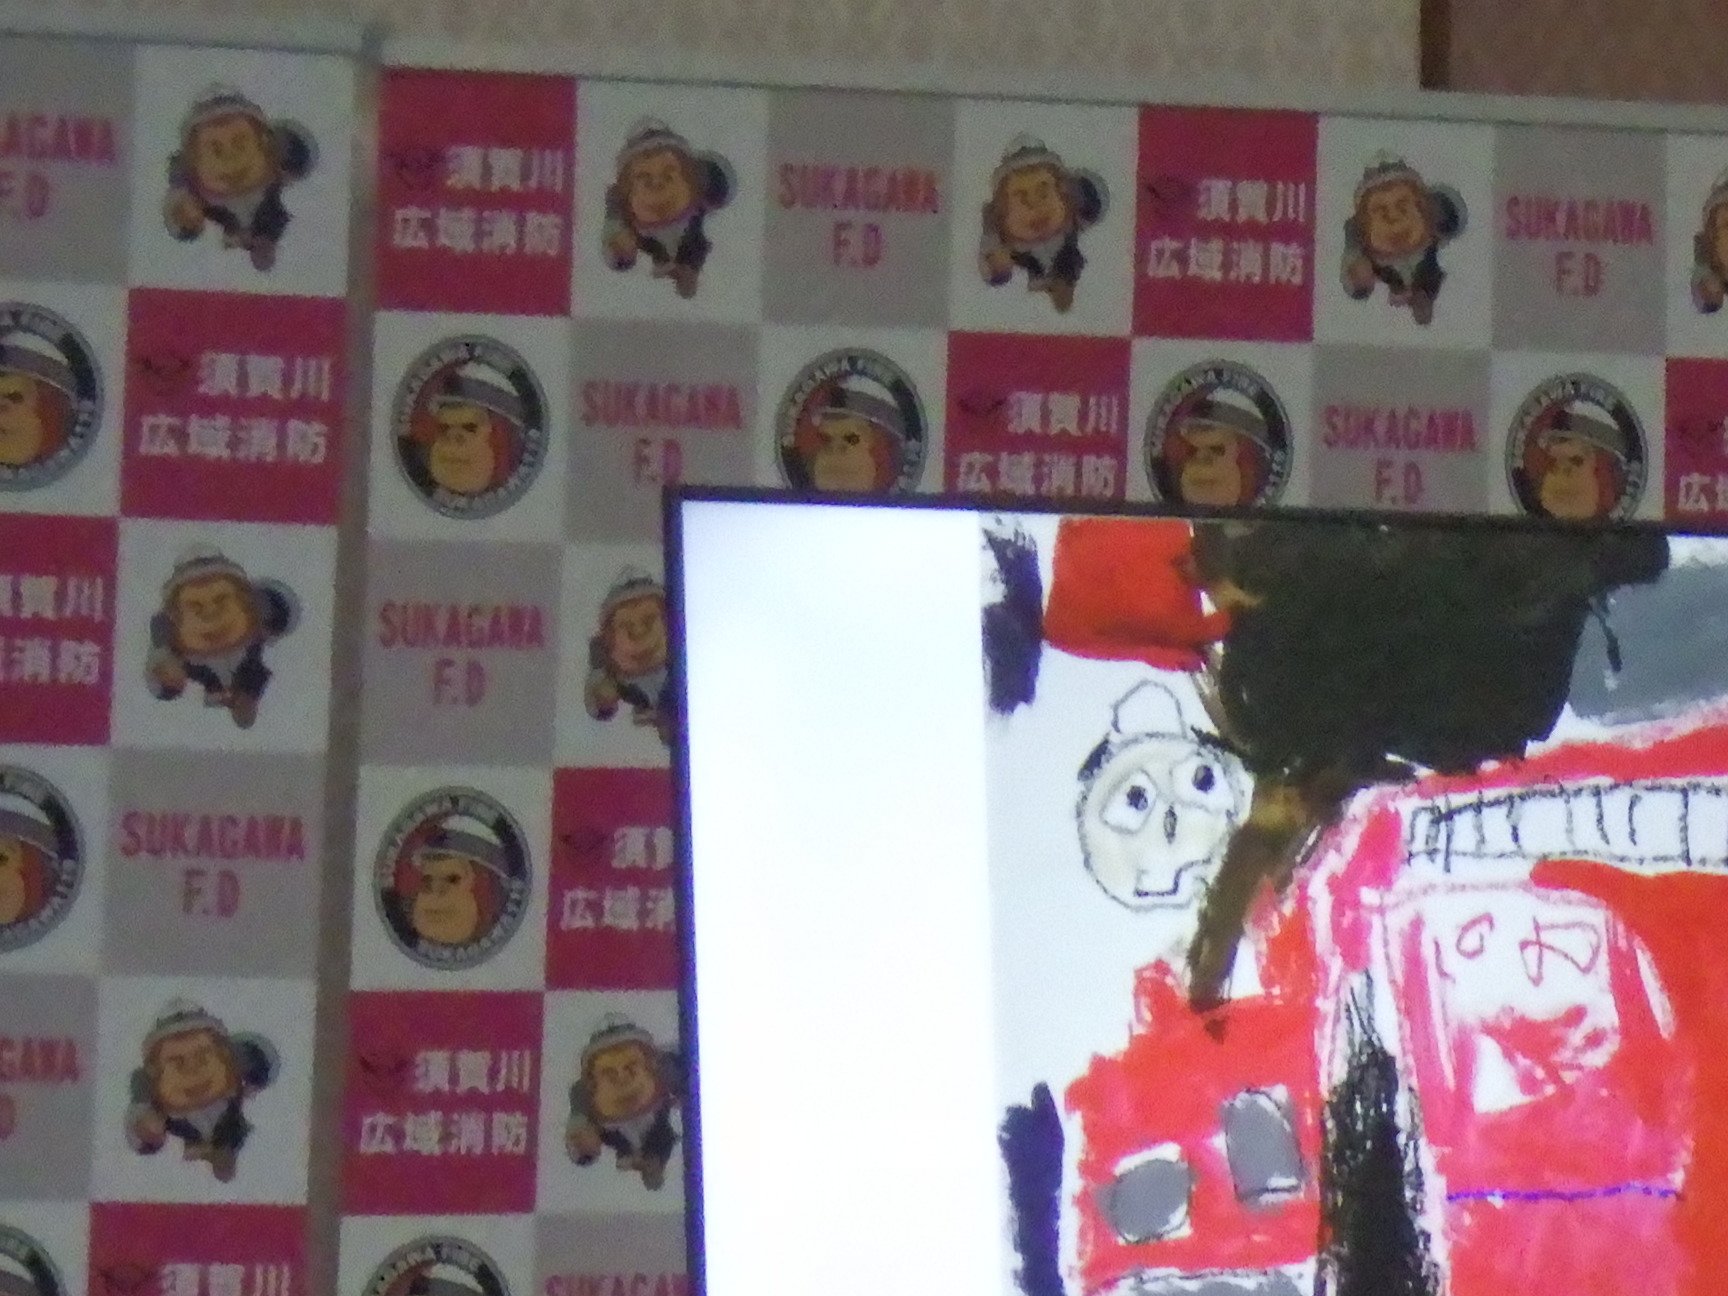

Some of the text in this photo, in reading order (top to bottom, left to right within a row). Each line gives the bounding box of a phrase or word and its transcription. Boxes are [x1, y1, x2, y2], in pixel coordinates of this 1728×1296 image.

[0, 113, 117, 168] AGAWA
[446, 147, 564, 193] 須賀川
[780, 163, 940, 213] SUKAGAWA
[1200, 177, 1306, 222] 須賀川
[1506, 196, 1653, 245] SUKAGAWA
[393, 206, 561, 256] 広域消防
[1147, 236, 1305, 285] 広域消防
[199, 353, 330, 401] 須賀川
[580, 380, 743, 430] SUKAGAWA
[1008, 391, 1118, 437] 須賀川
[140, 413, 328, 463] 広域消防
[1320, 406, 1478, 452] SUKAGAWA
[957, 452, 1115, 497] 広域消防
[380, 603, 543, 649] SUKAGAWA
[0, 637, 100, 684] 消防
[119, 811, 305, 861] SUKAGAWA
[560, 887, 677, 930] 広域消
[414, 1050, 530, 1093] 須賀川
[360, 1111, 528, 1155] 広域消防
